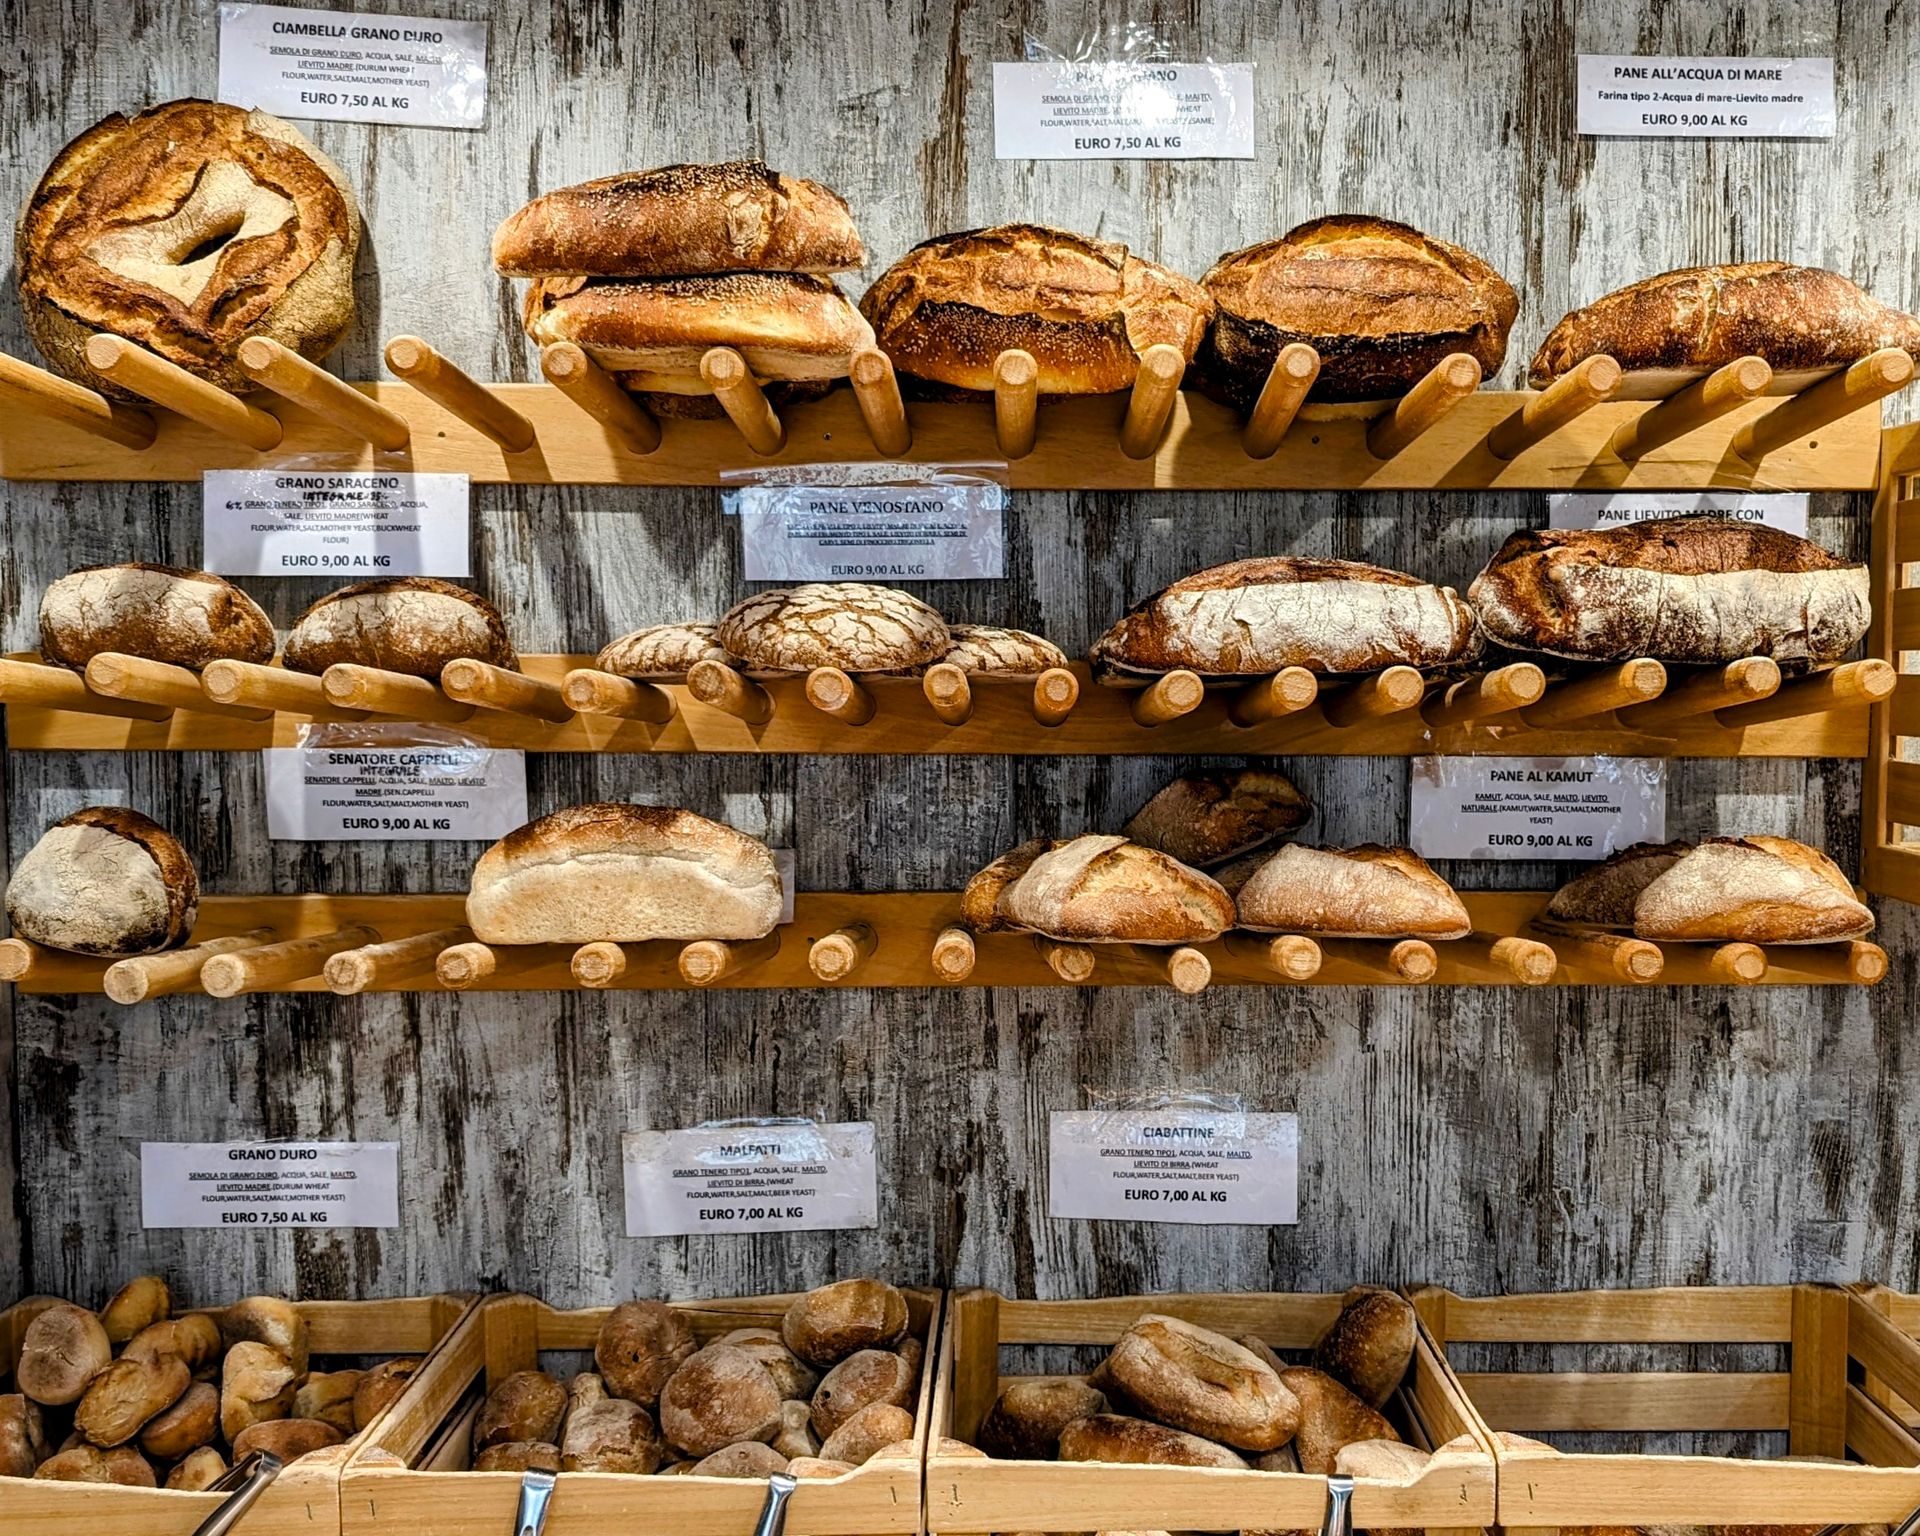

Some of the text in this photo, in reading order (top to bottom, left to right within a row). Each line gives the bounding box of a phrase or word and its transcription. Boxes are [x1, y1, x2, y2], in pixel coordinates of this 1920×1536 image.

[273, 22, 442, 43] CIAMBELLA GRANO DURO
[270, 46, 300, 55] SEMOLA
[302, 48, 310, 56] DI
[312, 49, 338, 58] GRANO
[365, 53, 393, 61] ACQUA,
[395, 54, 414, 62] SALE,
[298, 61, 325, 69] LIEVITO
[1614, 67, 1648, 79] PANE
[1728, 69, 1740, 80] DI
[1744, 69, 1782, 81] MARE
[301, 92, 409, 109] EURO 7,50 AL KG
[1598, 91, 1803, 104] Farina tipo 2-Acqua di mare-Lievito madre
[1642, 114, 1748, 127] EURO 9,00 AL KG
[1075, 136, 1181, 151] EURO 7,50 AL KG
[276, 477, 399, 489] GRANO SARACENO
[245, 501, 274, 509] GRANO
[329, 501, 355, 509] GRANO
[400, 501, 428, 509] ACQUA,
[810, 501, 943, 514] PANE VENOSTANO
[305, 513, 332, 521] LIEVITO
[1598, 510, 1630, 520] PANE
[1736, 510, 1764, 520] CON
[323, 536, 349, 545] FLOUR)
[282, 555, 391, 568] EURO 9,00 AL KG
[832, 565, 924, 577] EURO 9,00 AL KG
[329, 754, 458, 766] SENATORE CAPPELLI
[360, 765, 420, 776] INTEGRALE
[305, 776, 340, 785] SENATORE
[379, 777, 406, 785] ACQUA,
[1490, 771, 1593, 783] PANE AL KAMUT
[1505, 794, 1532, 802] ACQUA,
[1582, 795, 1608, 803] LIEVITO
[444, 800, 469, 809] YEAST)
[343, 818, 450, 831] EURO 9,00 AL KG
[1529, 817, 1553, 825] YEAST)
[1488, 835, 1593, 848] EURO 9,00 AL KG
[1143, 1127, 1214, 1139] CIABATTINE
[229, 1149, 317, 1160] GRANO DURO
[720, 1144, 781, 1156] MALFATTI
[1100, 1149, 1125, 1157] GRANO
[1127, 1149, 1154, 1157] TENERO
[1179, 1150, 1205, 1158] ACQUA,
[1133, 1161, 1159, 1169] LIEVITO
[1161, 1161, 1168, 1169] DI
[220, 1172, 228, 1180] DI
[229, 1172, 255, 1180] GRANO
[673, 1169, 698, 1177] GRANO
[701, 1168, 728, 1177] TENERO
[753, 1167, 779, 1175] ACQUA,
[1215, 1173, 1240, 1181] YEAST)
[217, 1184, 243, 1192] LIEVITO
[707, 1180, 733, 1188] LIEVITO
[735, 1179, 743, 1187] DI
[321, 1194, 345, 1202] YEAST)
[792, 1189, 815, 1197] YEAST)
[1125, 1189, 1227, 1203] EURO 7,00 AL KG
[222, 1212, 327, 1225] EURO 7,50 AL KG
[700, 1207, 803, 1221] EURO 7,00 AL KG
